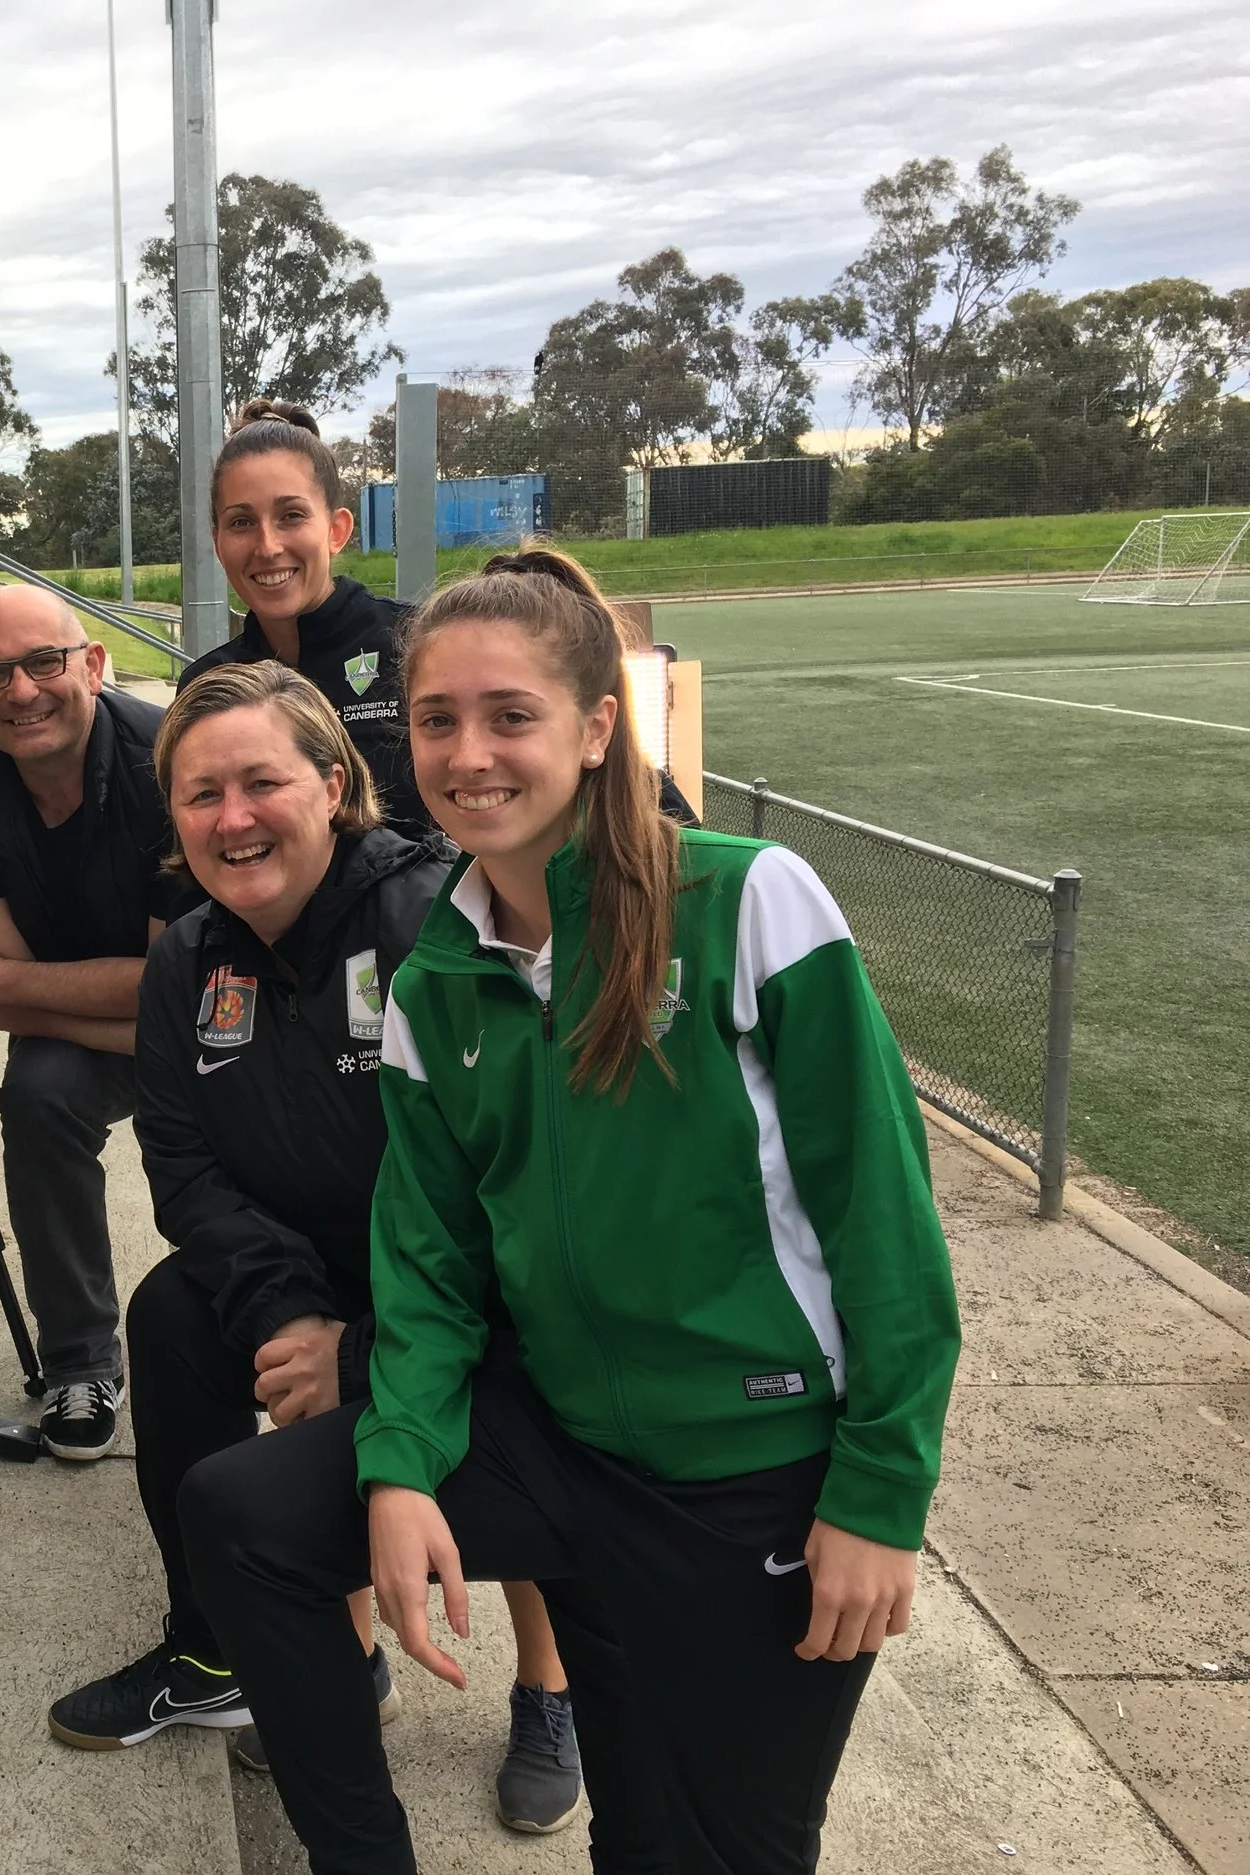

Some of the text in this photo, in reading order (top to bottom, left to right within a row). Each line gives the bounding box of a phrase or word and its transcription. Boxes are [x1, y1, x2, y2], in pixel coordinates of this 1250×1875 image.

[343, 700, 399, 712] UNIVERSITY OF
[343, 708, 399, 722] CANBERRA
[204, 1032, 243, 1040] W-LEAGUE
[749, 1377, 784, 1385] AUTHENTIC
[768, 1386, 786, 1394] TEAM
